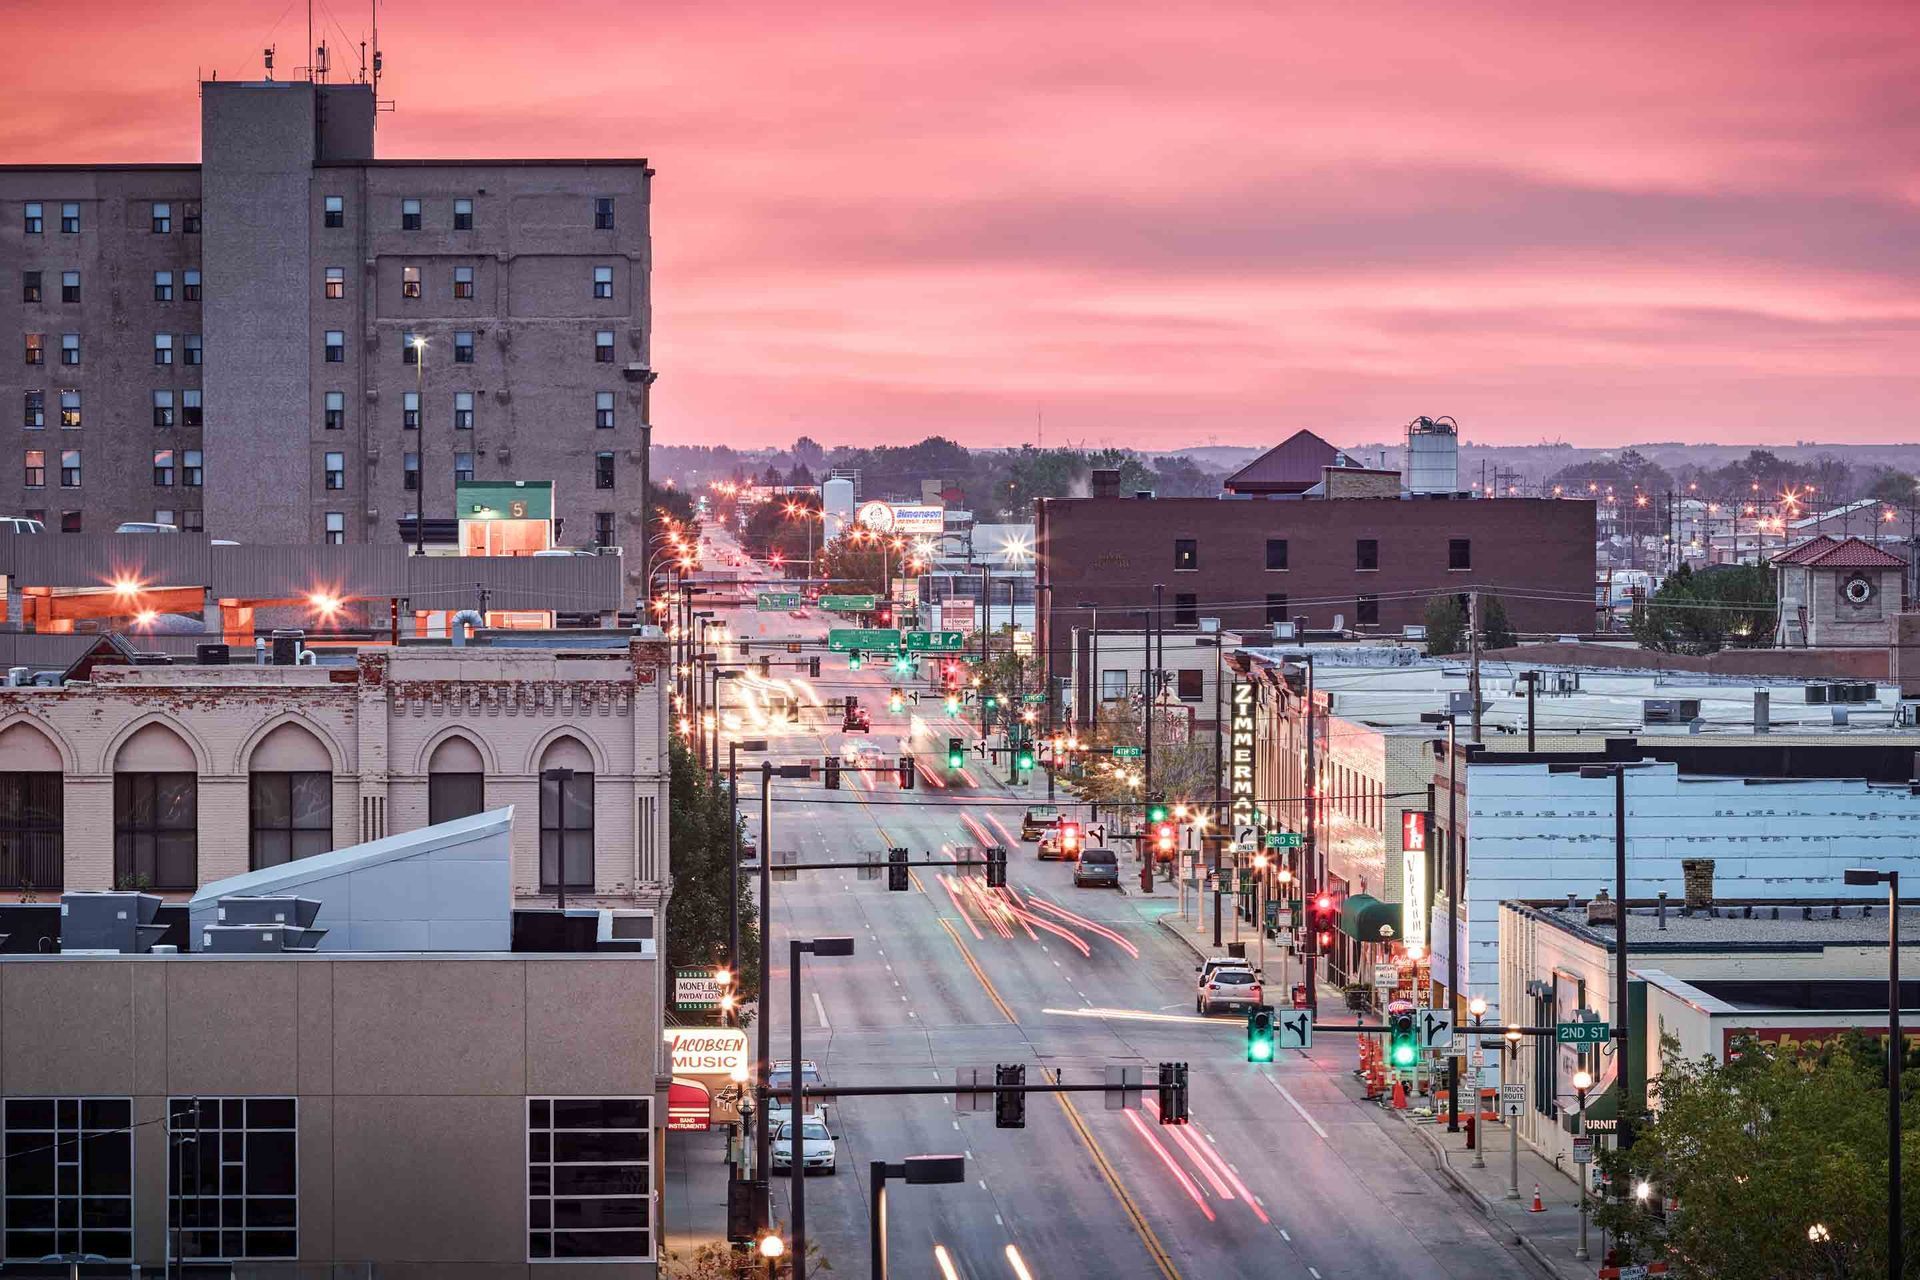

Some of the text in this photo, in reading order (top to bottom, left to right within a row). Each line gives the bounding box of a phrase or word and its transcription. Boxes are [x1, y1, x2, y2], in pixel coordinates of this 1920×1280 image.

[513, 503, 523, 517] 5
[1233, 684, 1253, 826] ZIMMERMAN
[1269, 836, 1300, 845] 3RD ST
[678, 982, 705, 990] MONEY
[1399, 989, 1431, 999] INTENET
[1561, 1027, 1605, 1038] 2ND ST
[672, 1056, 737, 1068] MUSIC
